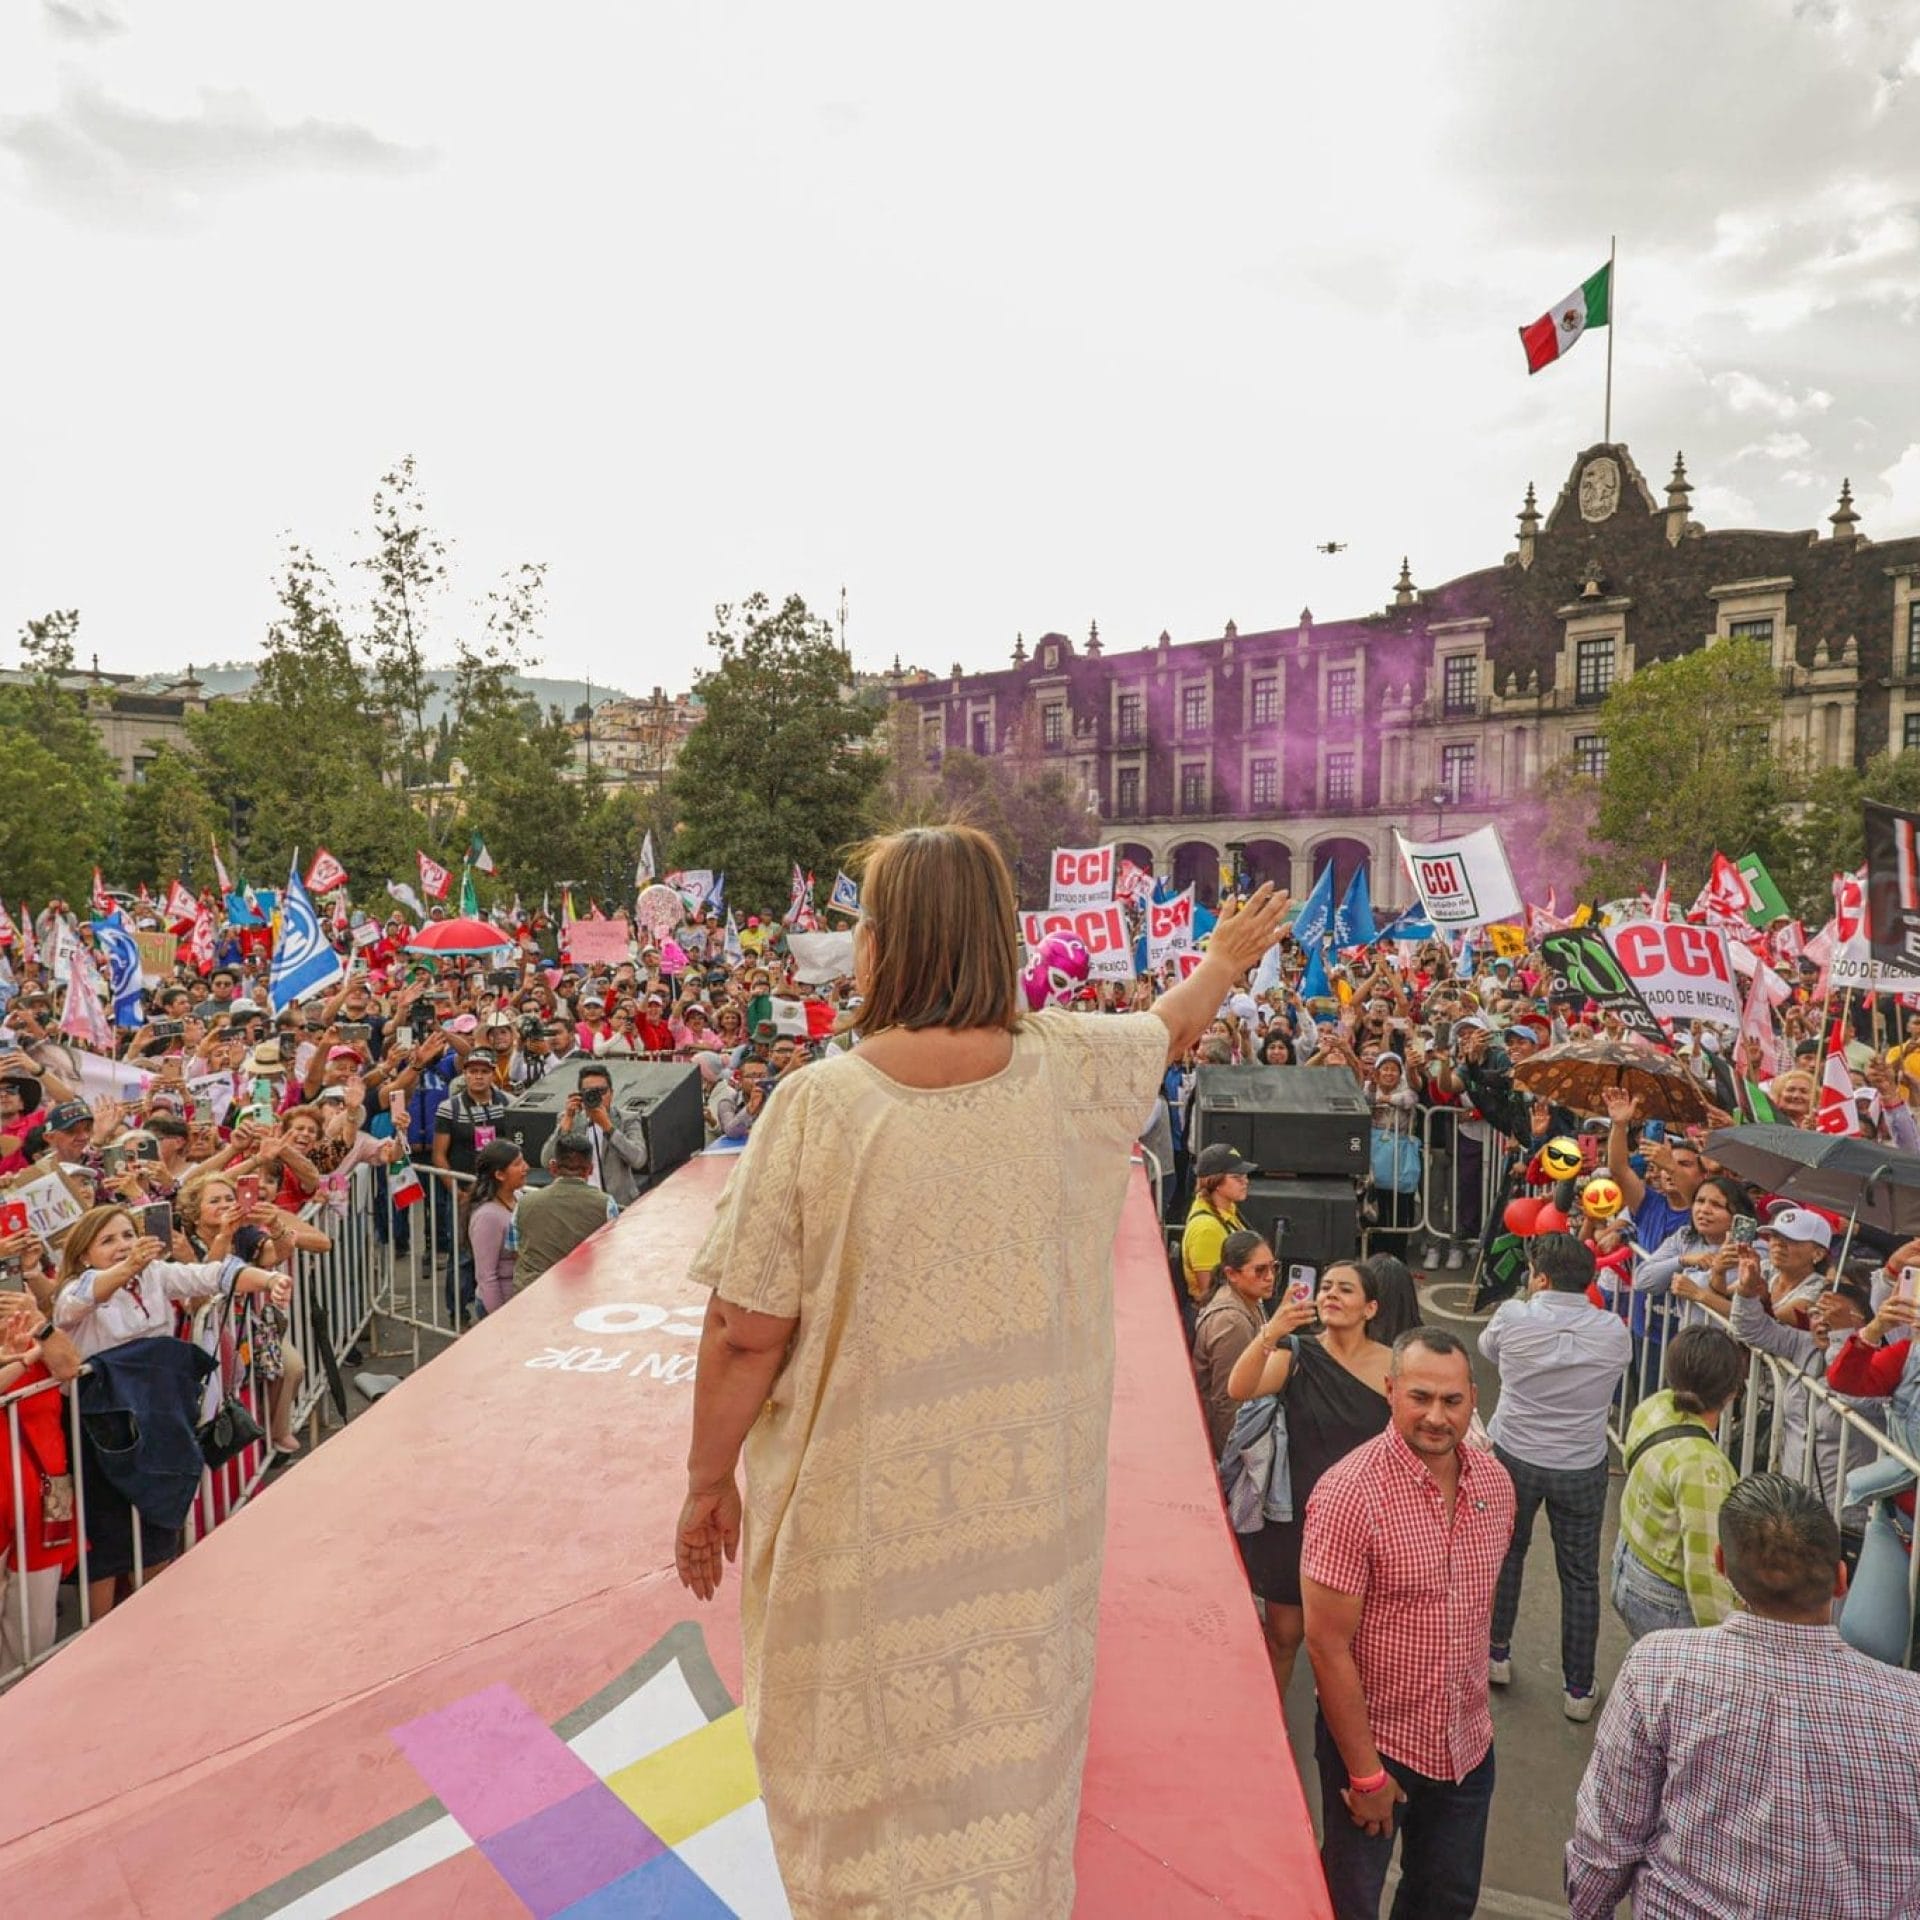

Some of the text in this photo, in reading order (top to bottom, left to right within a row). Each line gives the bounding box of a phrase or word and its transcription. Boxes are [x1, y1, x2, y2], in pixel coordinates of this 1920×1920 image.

[1056, 850, 1110, 886] CCI
[1422, 861, 1459, 895] CCI
[1615, 925, 1730, 983] CCI
[1677, 990, 1695, 1005] DE
[523, 1346, 631, 1373] POR
